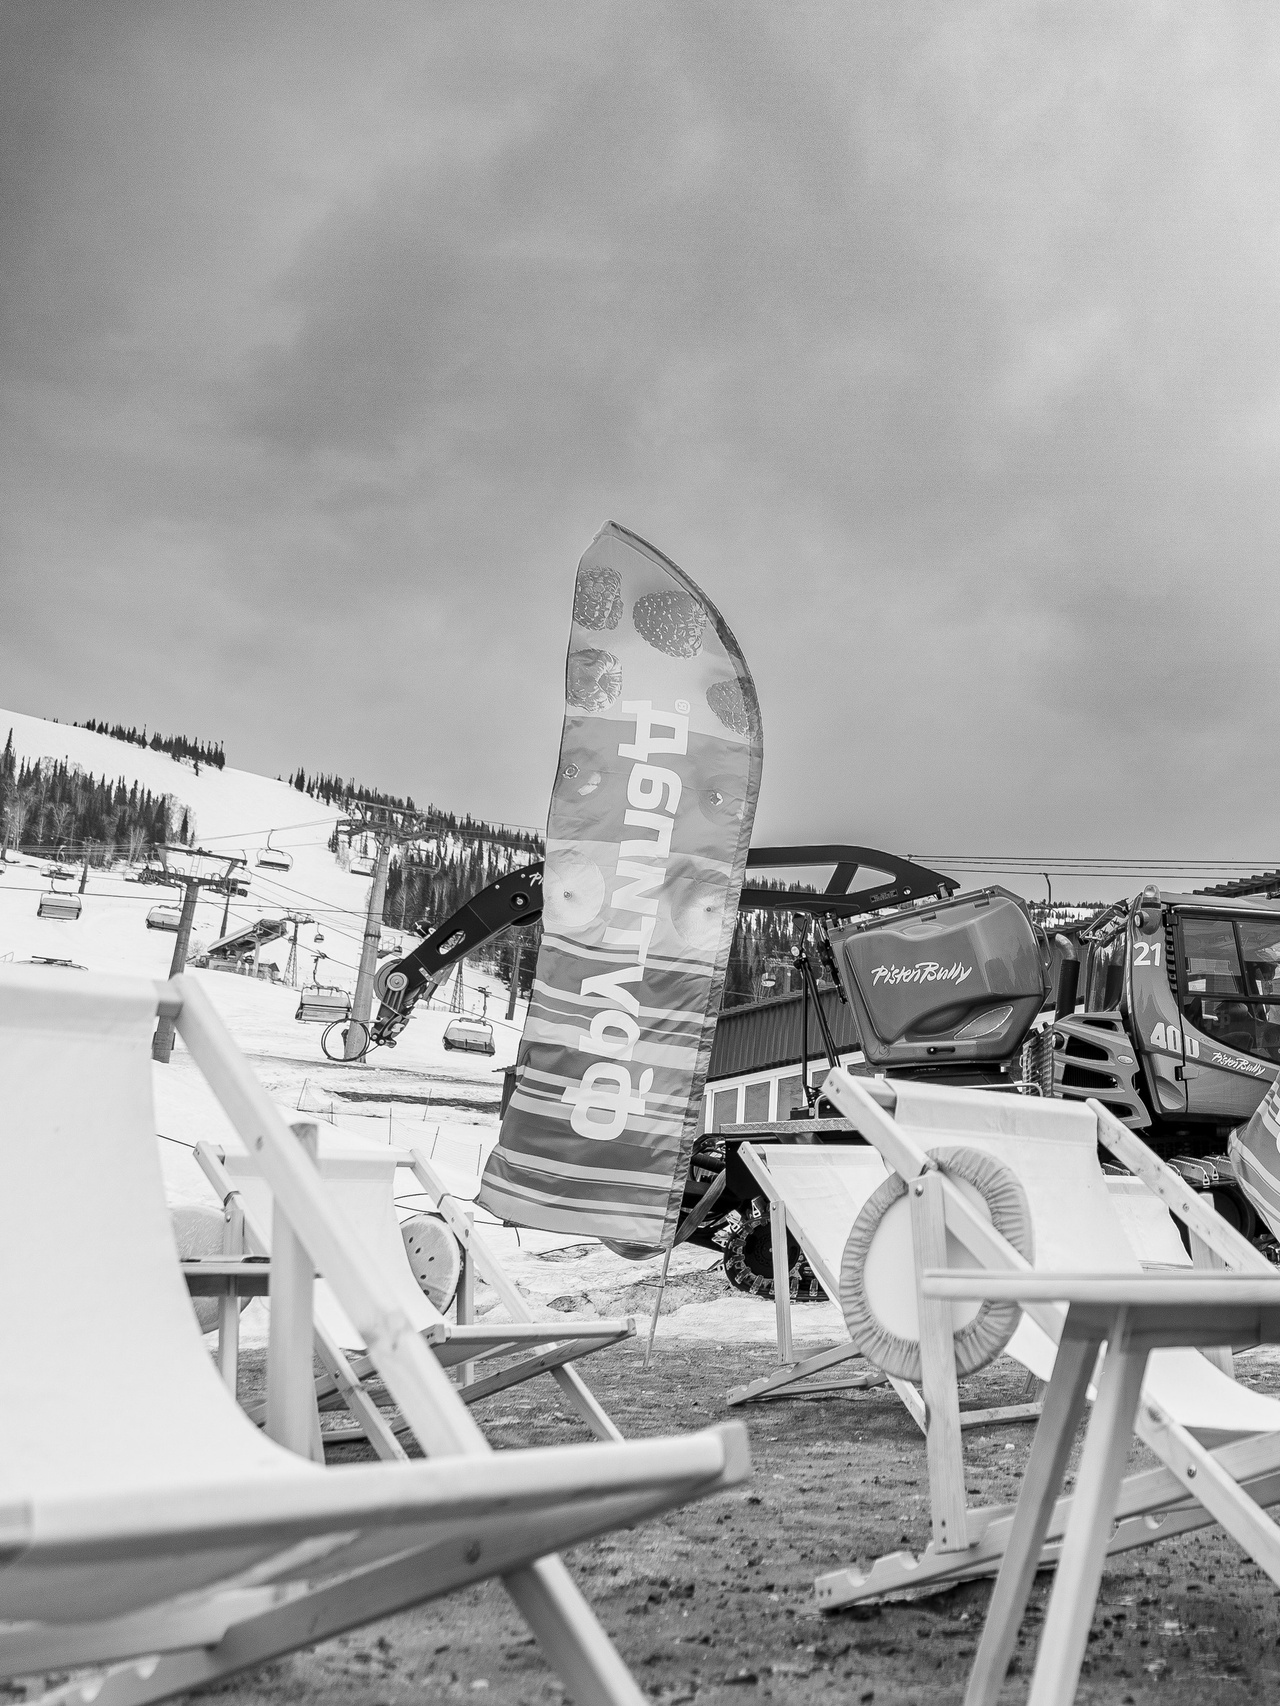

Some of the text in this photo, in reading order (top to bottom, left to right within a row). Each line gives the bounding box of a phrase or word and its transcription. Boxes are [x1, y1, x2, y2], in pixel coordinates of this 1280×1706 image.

[1133, 942, 1162, 967] 21
[871, 961, 973, 987] PistenBully
[1150, 1022, 1200, 1059] 400
[1211, 1052, 1266, 1077] PistenBully
